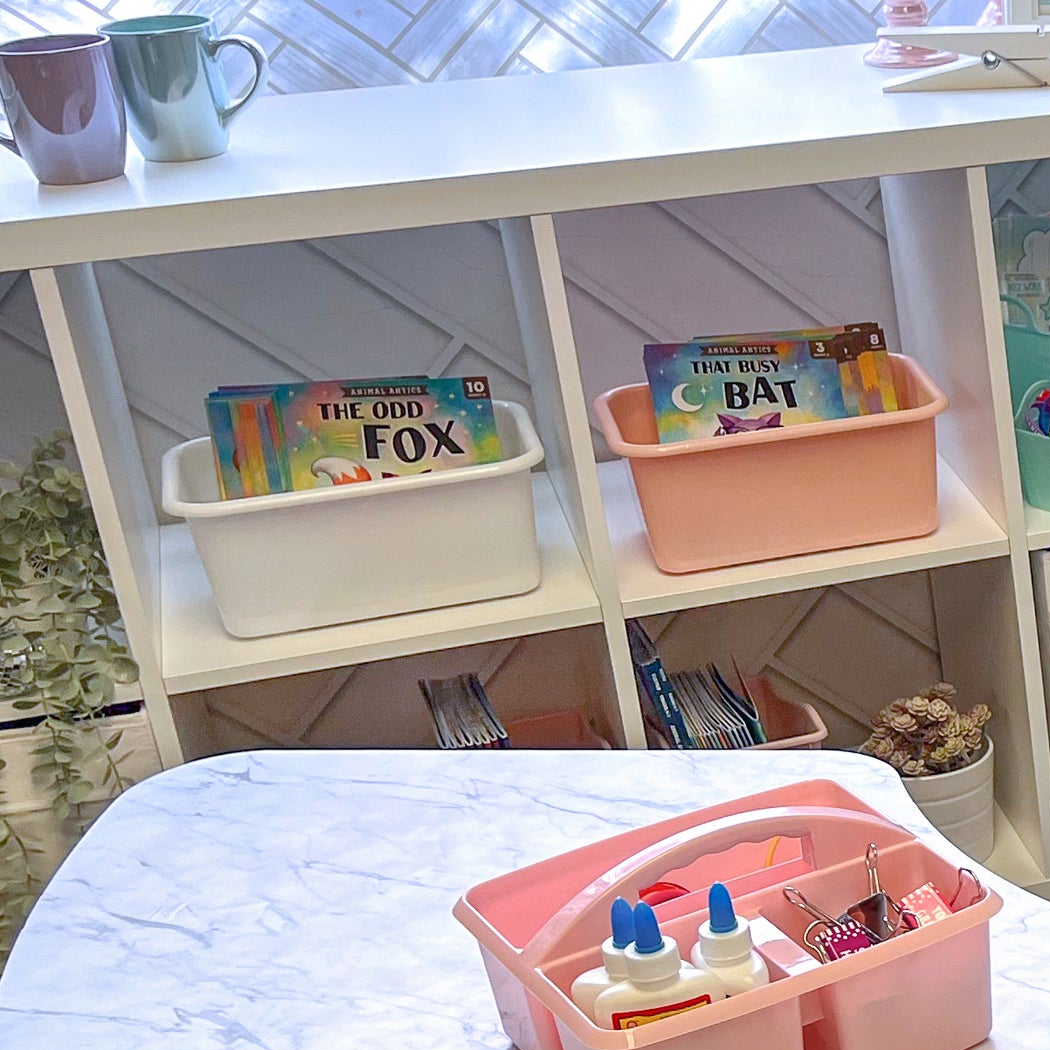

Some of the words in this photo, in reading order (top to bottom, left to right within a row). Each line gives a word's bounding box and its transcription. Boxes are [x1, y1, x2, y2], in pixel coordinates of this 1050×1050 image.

[869, 333, 880, 345] 8
[707, 346, 740, 354] ANIMAL
[742, 345, 771, 353] ANTICS
[815, 341, 826, 353] 3
[691, 360, 731, 374] THAT
[738, 360, 780, 373] BUSY
[350, 387, 386, 396] ANIMAL
[389, 386, 422, 394] ANTICS
[466, 381, 485, 393] 10
[723, 376, 798, 409] BAT
[317, 403, 365, 420] THE
[372, 400, 424, 419] ODD
[363, 420, 465, 463] FOX
